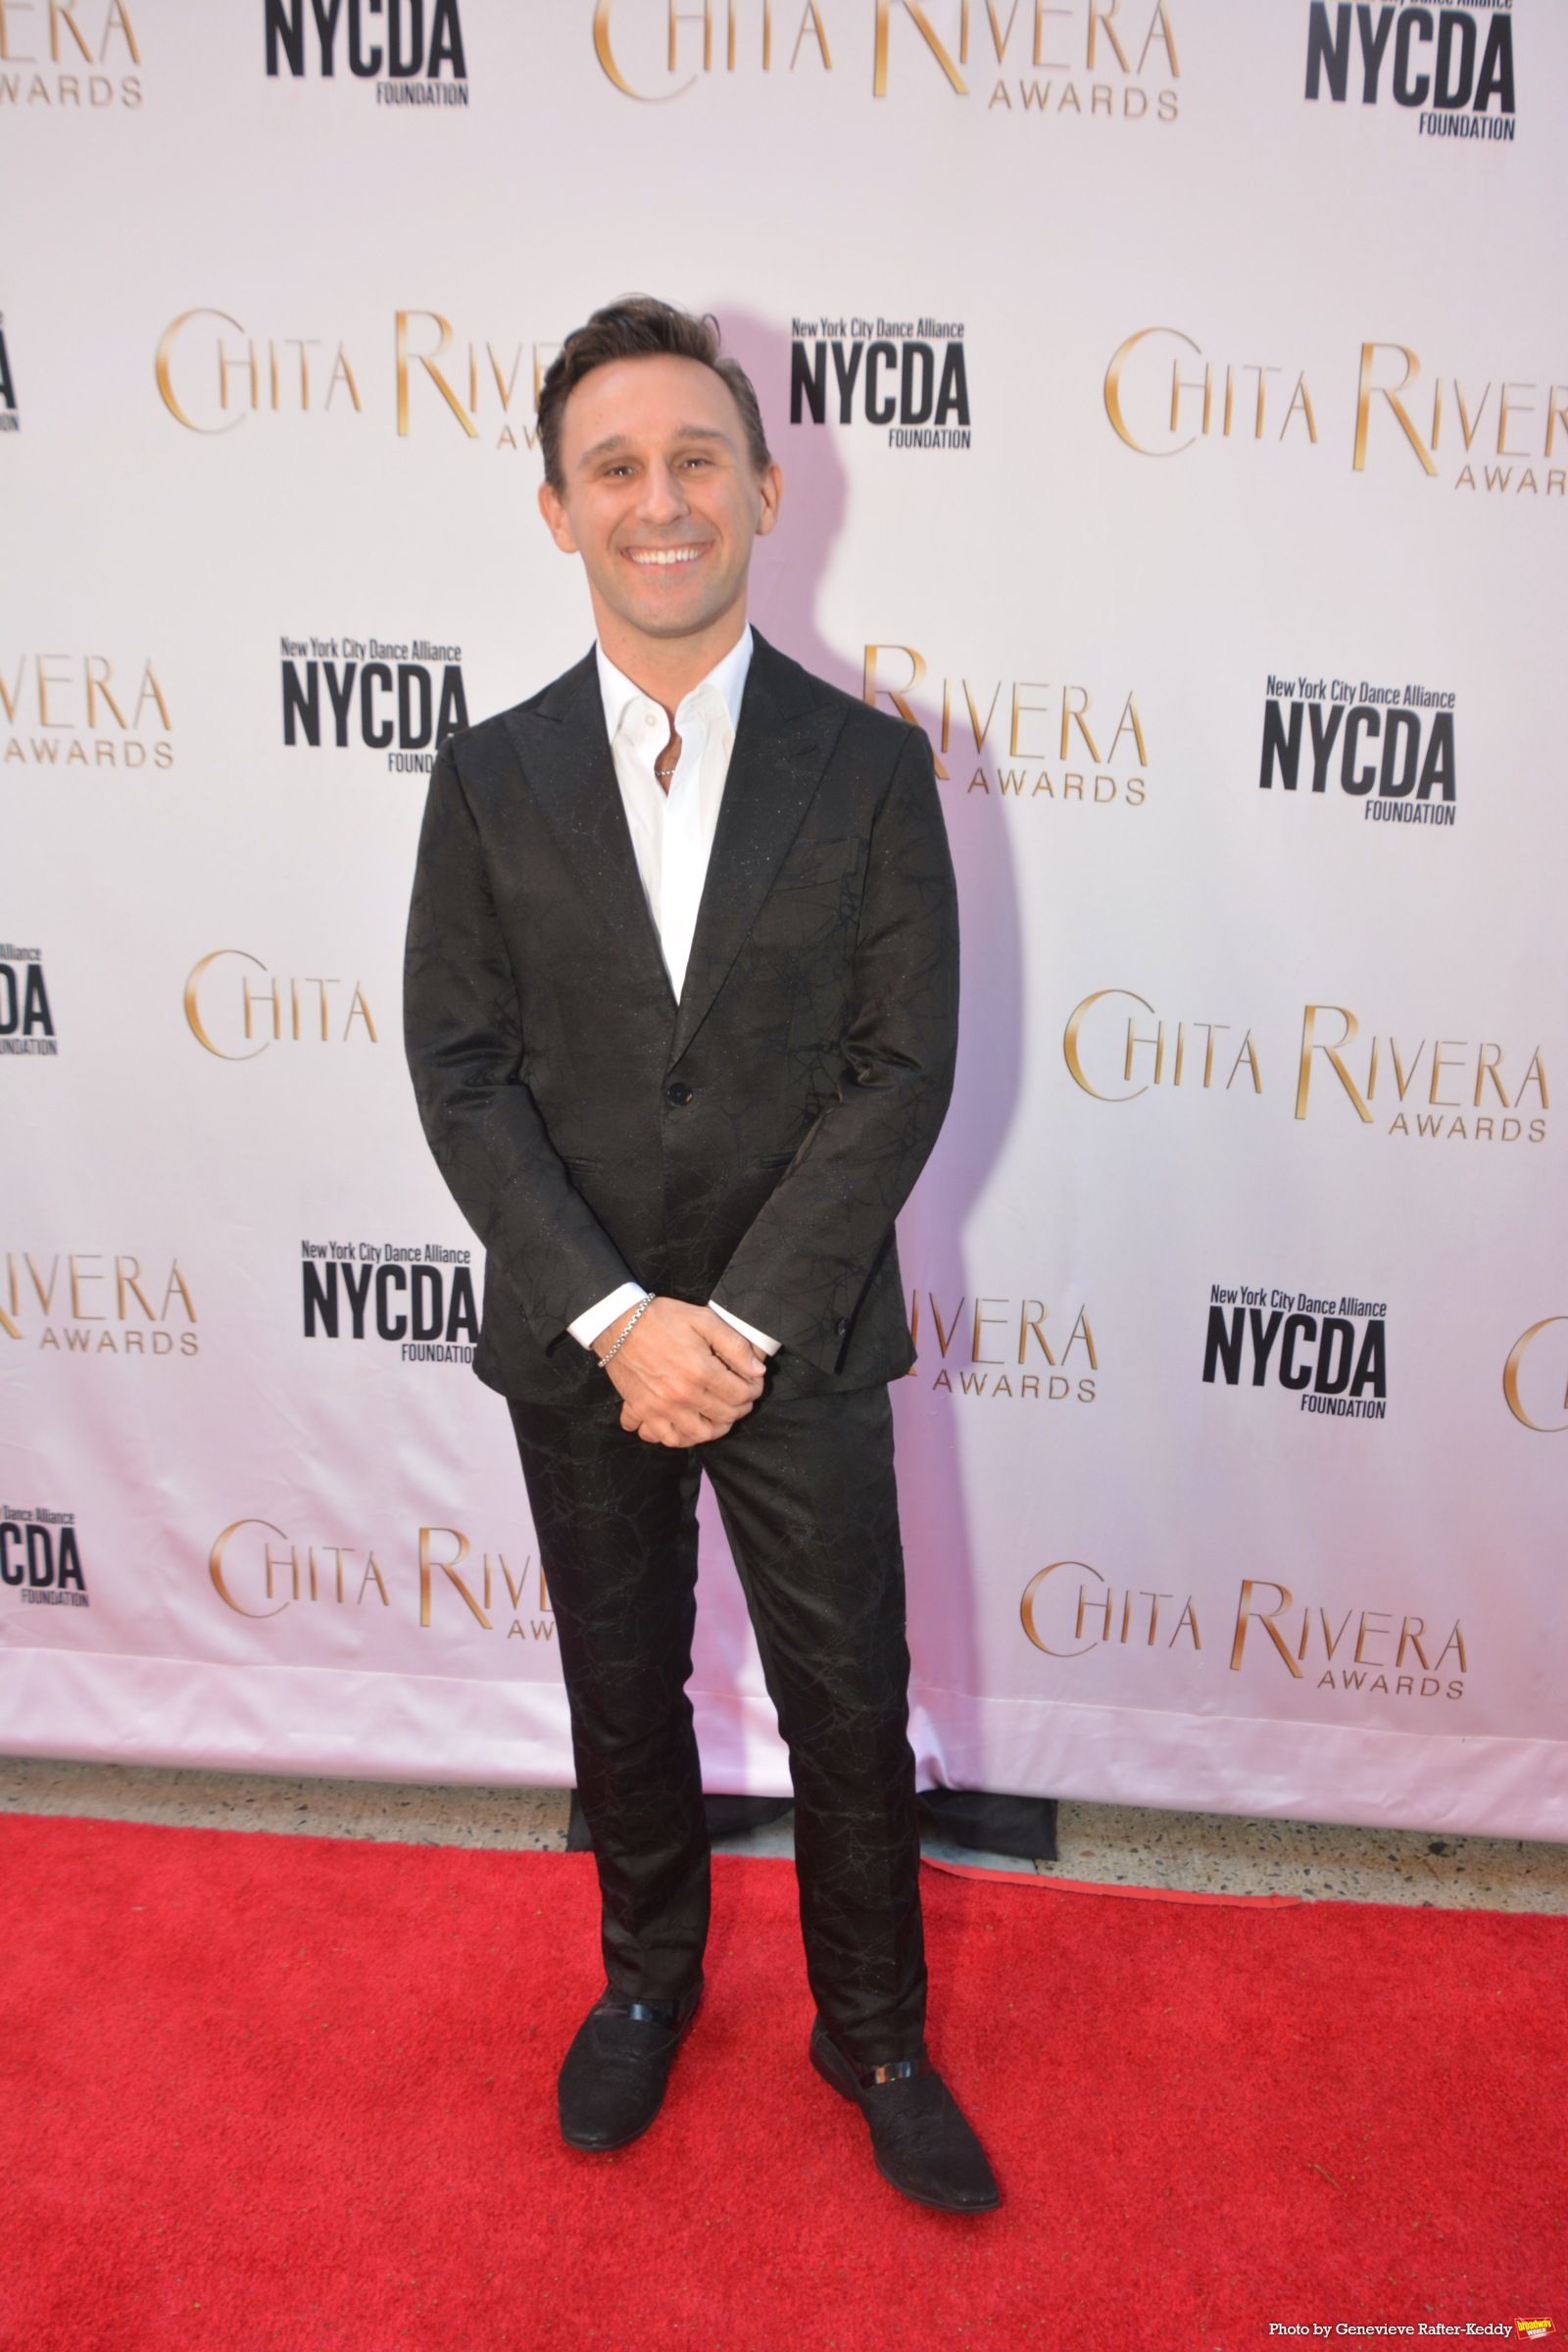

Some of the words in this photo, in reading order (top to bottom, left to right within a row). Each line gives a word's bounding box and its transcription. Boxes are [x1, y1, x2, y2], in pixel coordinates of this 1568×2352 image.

[265, 0, 468, 78] NYCDA
[1304, 0, 1516, 114] NYCDA
[376, 81, 469, 106] FOUNDATION
[988, 78, 1180, 122] AWARDS
[1419, 112, 1516, 141] FOUNDATION
[792, 318, 817, 337] New
[820, 318, 847, 338] York
[851, 318, 873, 339] City
[876, 318, 913, 338] Dance
[917, 318, 964, 338] Alliance
[155, 308, 362, 434] CHITA
[790, 340, 970, 426] NYCDA
[1103, 327, 1318, 458] CHITA
[889, 428, 971, 449] FOUNDATION
[280, 636, 308, 657] New
[311, 637, 338, 659] York
[343, 638, 367, 661] City
[369, 639, 409, 661] Dance
[412, 640, 462, 662] Alliance
[281, 661, 469, 750] NYCDA
[1266, 674, 1296, 697] New
[1298, 677, 1327, 700] York
[1331, 679, 1356, 706] City
[1359, 681, 1399, 705] Dance
[1403, 684, 1455, 709] Alliance
[862, 644, 1148, 781] RIVERA
[4, 737, 173, 769] AWARDS
[1259, 699, 1456, 802] NYCDA
[967, 767, 1146, 807] AWARDS
[1364, 800, 1456, 826] FOUNDATION
[183, 950, 378, 1061] CHITA
[1063, 989, 1262, 1102] CHITA
[1295, 1004, 1550, 1125] RIVERA
[1388, 1112, 1547, 1144] AWARDS
[302, 1240, 326, 1258] New
[328, 1242, 356, 1260] York
[360, 1243, 382, 1263] City
[385, 1244, 421, 1262] Dance
[424, 1245, 470, 1264] Alliance
[302, 1260, 478, 1344] NYCDA
[1210, 1285, 1238, 1304] New
[1241, 1287, 1267, 1306] York
[1271, 1290, 1296, 1312] City
[1298, 1294, 1336, 1315] Dance
[1339, 1297, 1387, 1317] Alliance
[39, 1327, 200, 1356] AWARDS
[907, 1290, 1099, 1376] IVERA
[1202, 1305, 1387, 1398] NYCDA
[402, 1344, 477, 1364] FOUNDATIO
[932, 1369, 1097, 1403] AWARDS
[1300, 1395, 1387, 1419] FOUNDATION
[209, 1519, 390, 1619] CHITA
[21, 1588, 90, 1607] FOUNDATION
[1019, 1561, 1202, 1658] CHITA
[1229, 1579, 1468, 1680] RIVERA
[1317, 1669, 1465, 1700] AWARDS
